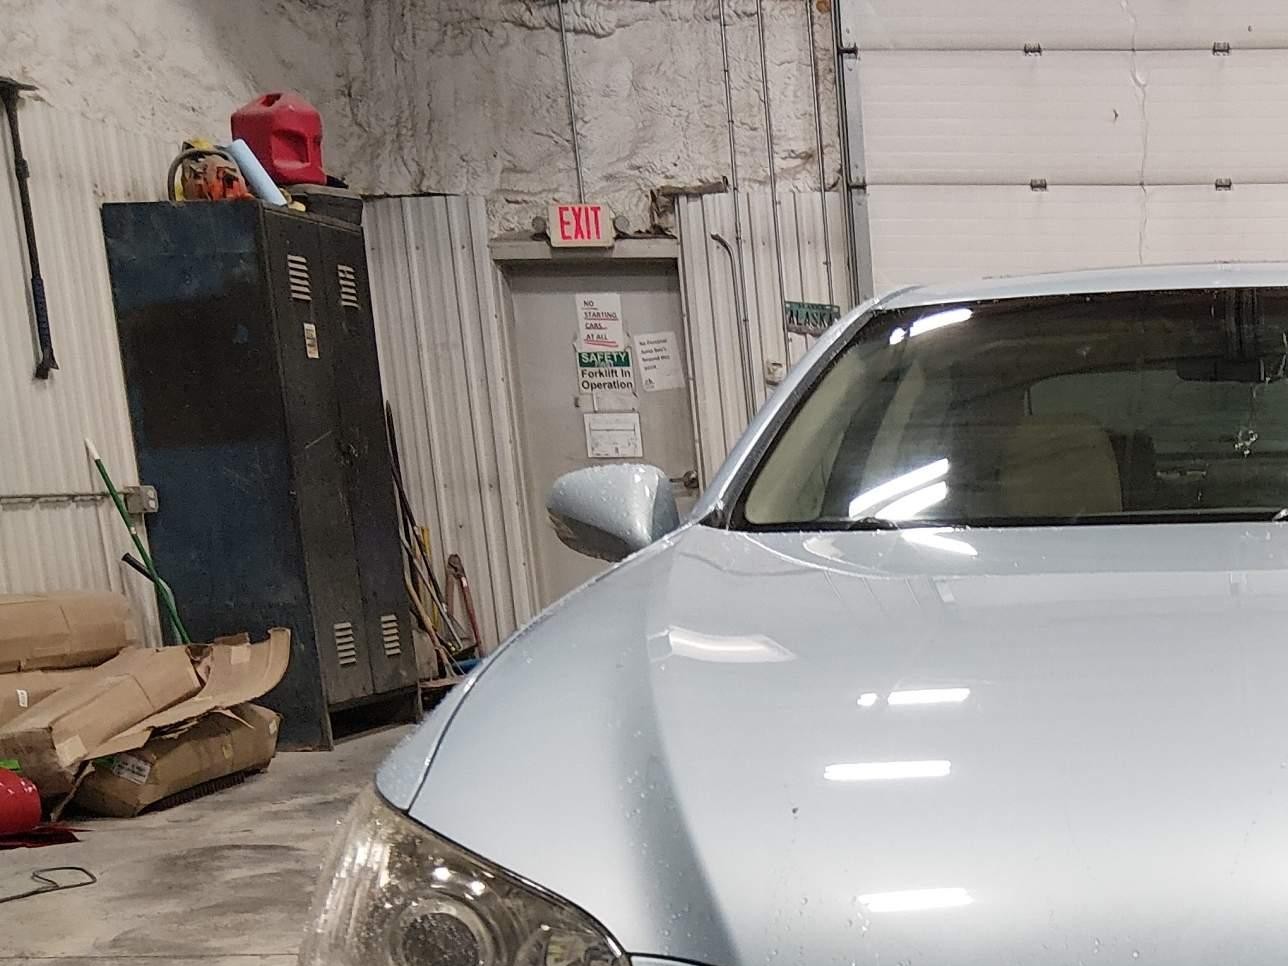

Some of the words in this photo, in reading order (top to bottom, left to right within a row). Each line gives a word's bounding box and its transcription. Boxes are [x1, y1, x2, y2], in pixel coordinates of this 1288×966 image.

[559, 206, 601, 240] EXIT
[788, 309, 833, 328] ALASKA
[581, 352, 627, 363] SAFETY
[581, 368, 619, 378] Forklift
[621, 368, 631, 378] In
[581, 380, 633, 391] Operation
